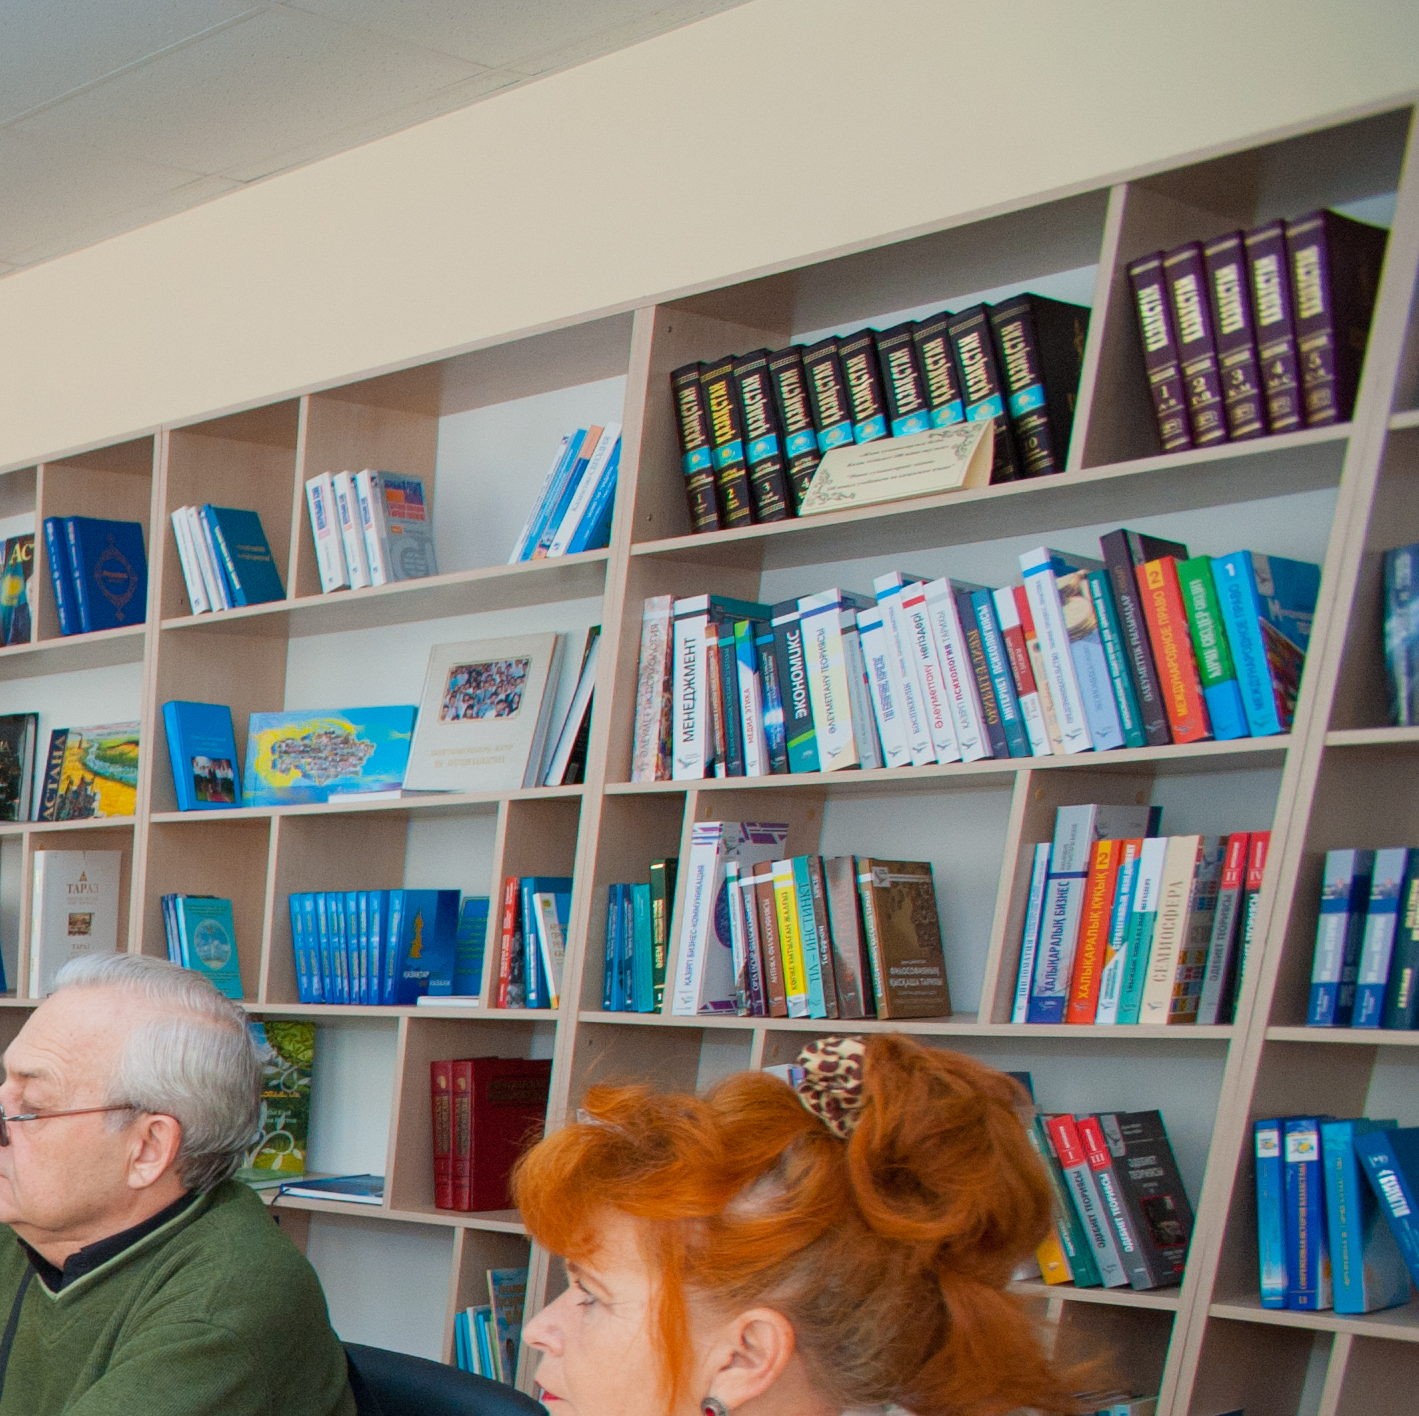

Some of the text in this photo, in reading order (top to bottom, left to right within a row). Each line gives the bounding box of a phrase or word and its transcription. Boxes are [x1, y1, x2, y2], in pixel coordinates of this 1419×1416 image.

[846, 353, 877, 420] ҚАЗАҚСТАН
[888, 348, 922, 414] ҚАЗАҚСТАН
[923, 337, 955, 405] ҚАЗАҚСТАН
[958, 332, 992, 401] ҚАЗАҚСТАН
[1001, 322, 1036, 390] ҚАЗАҚСТАН
[679, 386, 705, 449] ҚАЗАҚСТАН
[709, 380, 736, 444] ҚАЗАҚСТАН
[741, 374, 771, 438] ҚАЗАҚСТАН
[779, 368, 810, 431] ҚАЗАҚСТАН
[813, 361, 844, 425] ҚАЗАҚСТАН
[1150, 571, 1160, 584] 2
[1225, 562, 1235, 576] 1
[816, 628, 829, 674] ТЕОРИЯСЫ
[944, 643, 963, 701] психология
[978, 605, 1013, 720] ИНТЕРНЕТ ПСИХОЛОГИЯСЫ
[1156, 590, 1188, 717] МЕЖДУНАРОДНОЕ ПРАВО
[1228, 584, 1263, 711] МЕЖДУНАРОДНОЕ ПРАВО
[683, 638, 696, 742] МЕНЕДЖМЕНТ
[743, 688, 751, 715] ЭТИКА
[924, 664, 943, 729] Әлеуметтану
[42, 735, 66, 821] АСТАНА
[67, 883, 99, 894] ТАРАЗ
[1099, 852, 1109, 866] 2
[1054, 881, 1070, 919] БИЗНЕС
[1153, 881, 1184, 983] СЕМИОСФЕРА
[799, 882, 820, 984] ТІЛ ИНСТИНКТ
[1044, 919, 1066, 992] ХАЛЫҚАРАЛЫҚ
[1078, 871, 1107, 999] ХАЛЫҚАРАЛЫҚ ҚҰҚЫҚ
[1090, 1153, 1105, 1164] III
